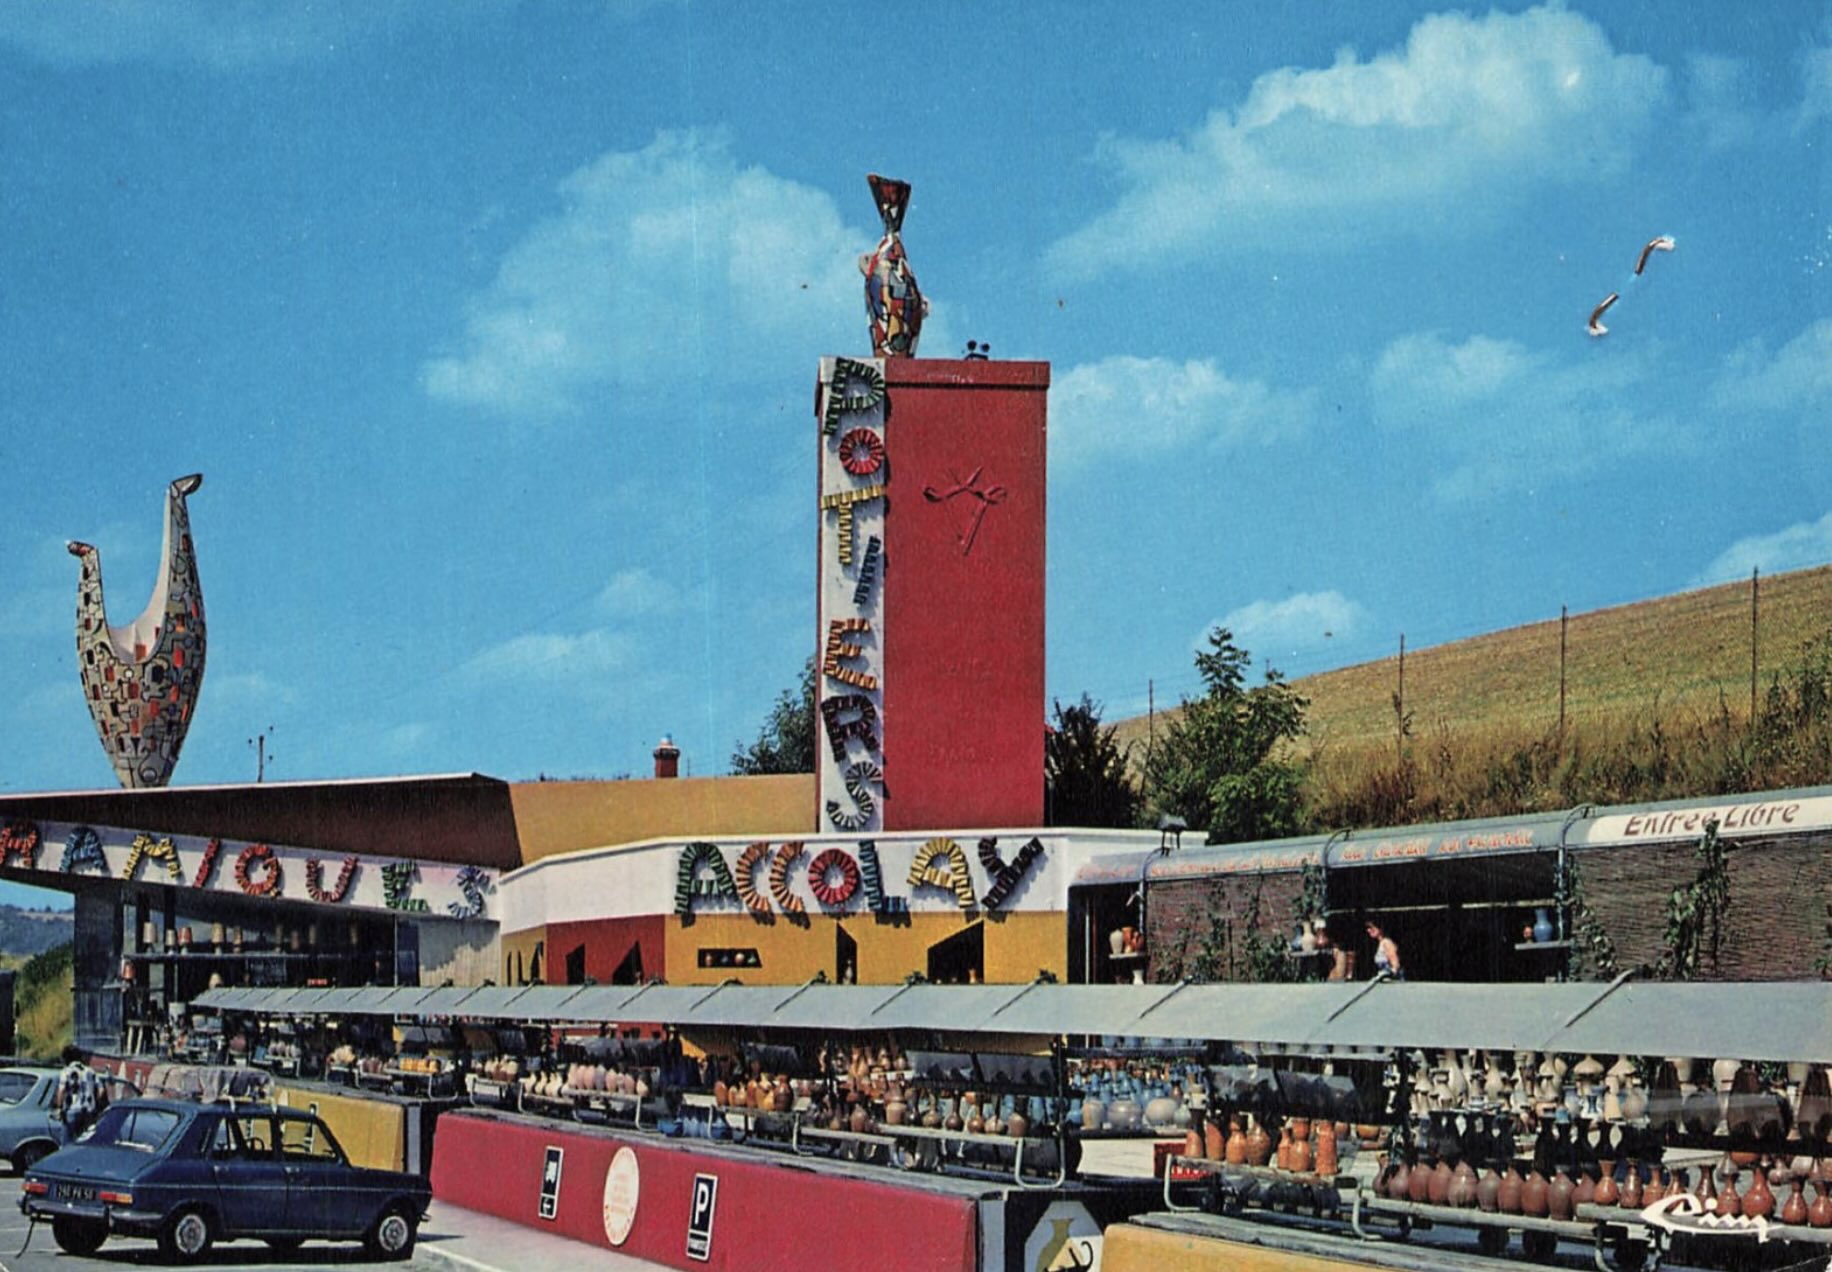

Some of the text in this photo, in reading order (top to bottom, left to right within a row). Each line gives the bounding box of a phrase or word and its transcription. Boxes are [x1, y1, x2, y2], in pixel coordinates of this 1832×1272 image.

[821, 356, 886, 831] POTIERS
[1723, 803, 1800, 829] Libre
[675, 837, 1045, 914] ACCOLAY
[694, 1182, 709, 1225] P
